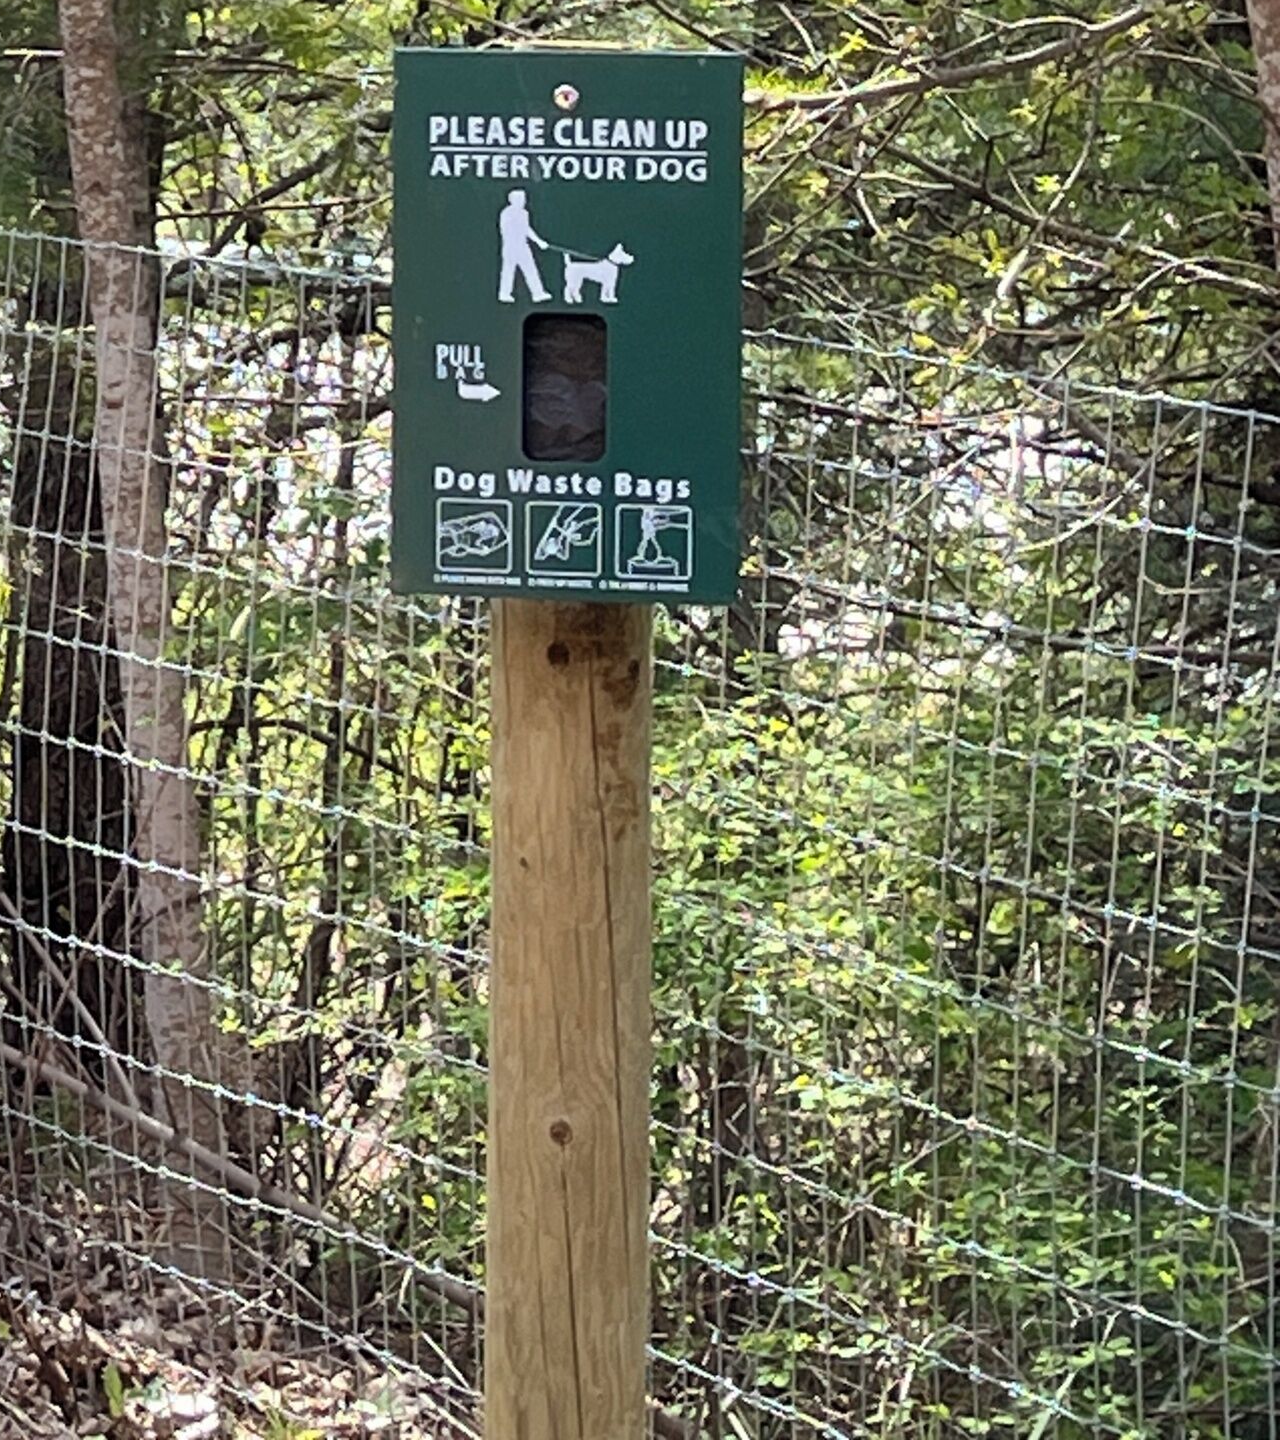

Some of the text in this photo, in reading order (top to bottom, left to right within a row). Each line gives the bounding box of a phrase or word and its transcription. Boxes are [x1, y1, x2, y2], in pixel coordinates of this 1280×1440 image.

[428, 116, 709, 149] PLEASE CLEAN UP
[429, 154, 709, 182] AFTER YOUR DOG
[435, 343, 485, 367] PULL
[433, 466, 691, 503] Dog Waste Bags
